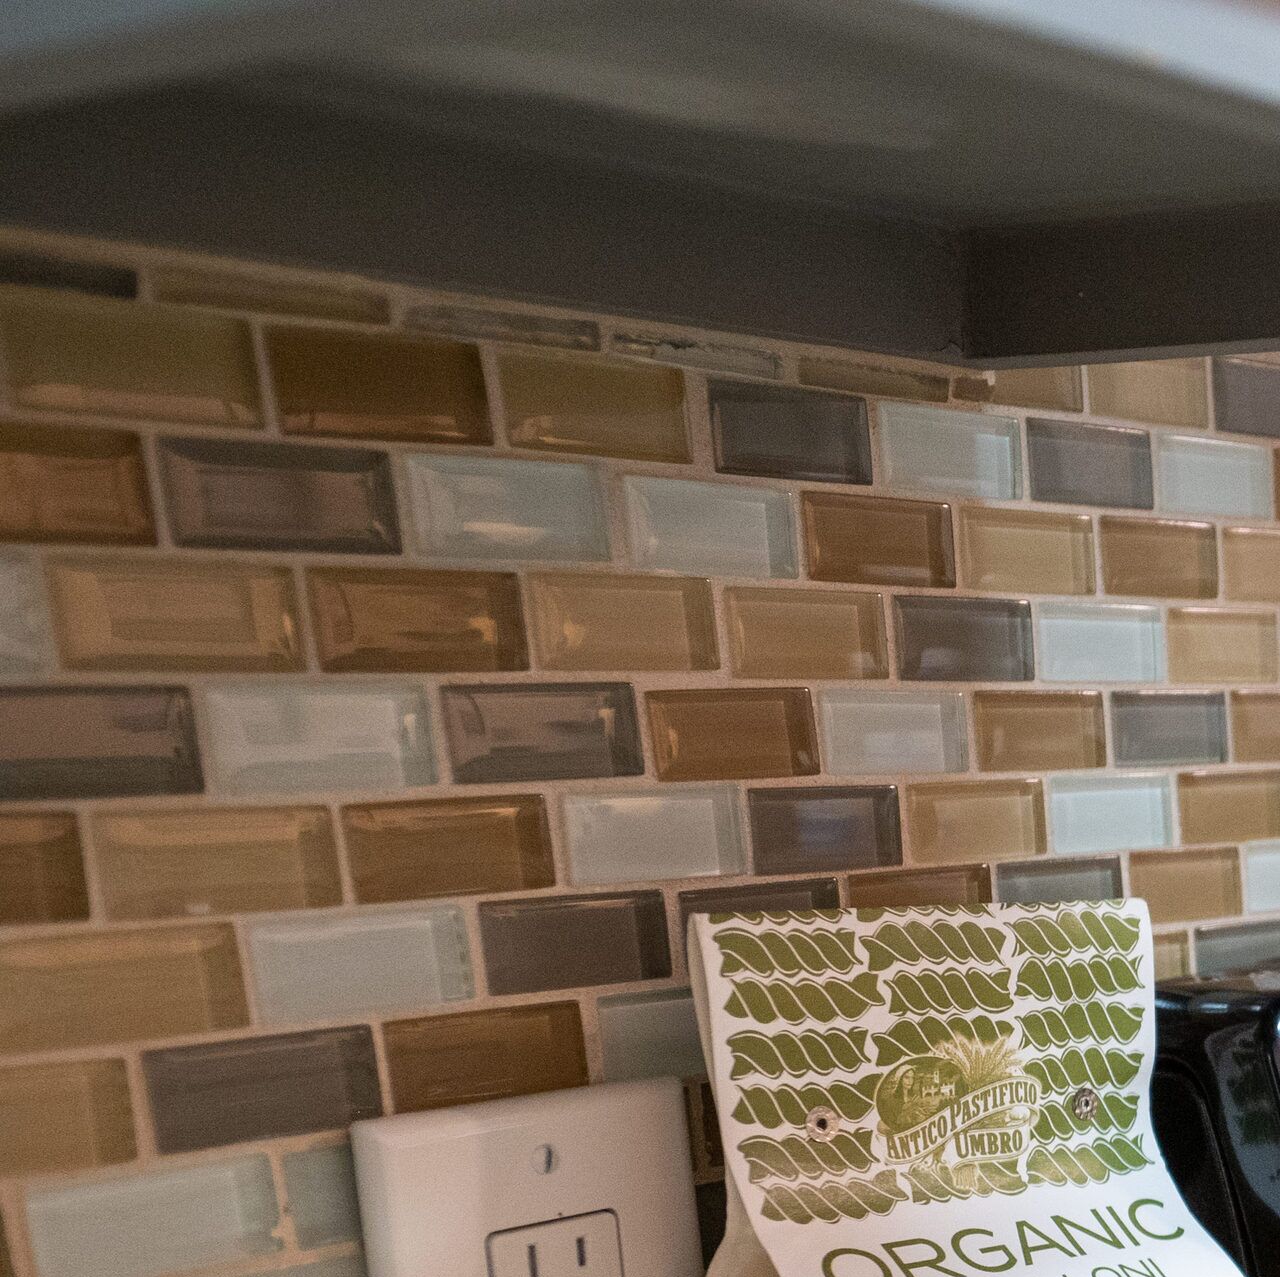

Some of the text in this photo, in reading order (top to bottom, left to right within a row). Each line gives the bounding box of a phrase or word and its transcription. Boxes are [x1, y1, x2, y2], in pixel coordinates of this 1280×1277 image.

[885, 1081, 1038, 1160] ANTICO PASTIFICIO
[953, 1129, 1023, 1159] UMBRO
